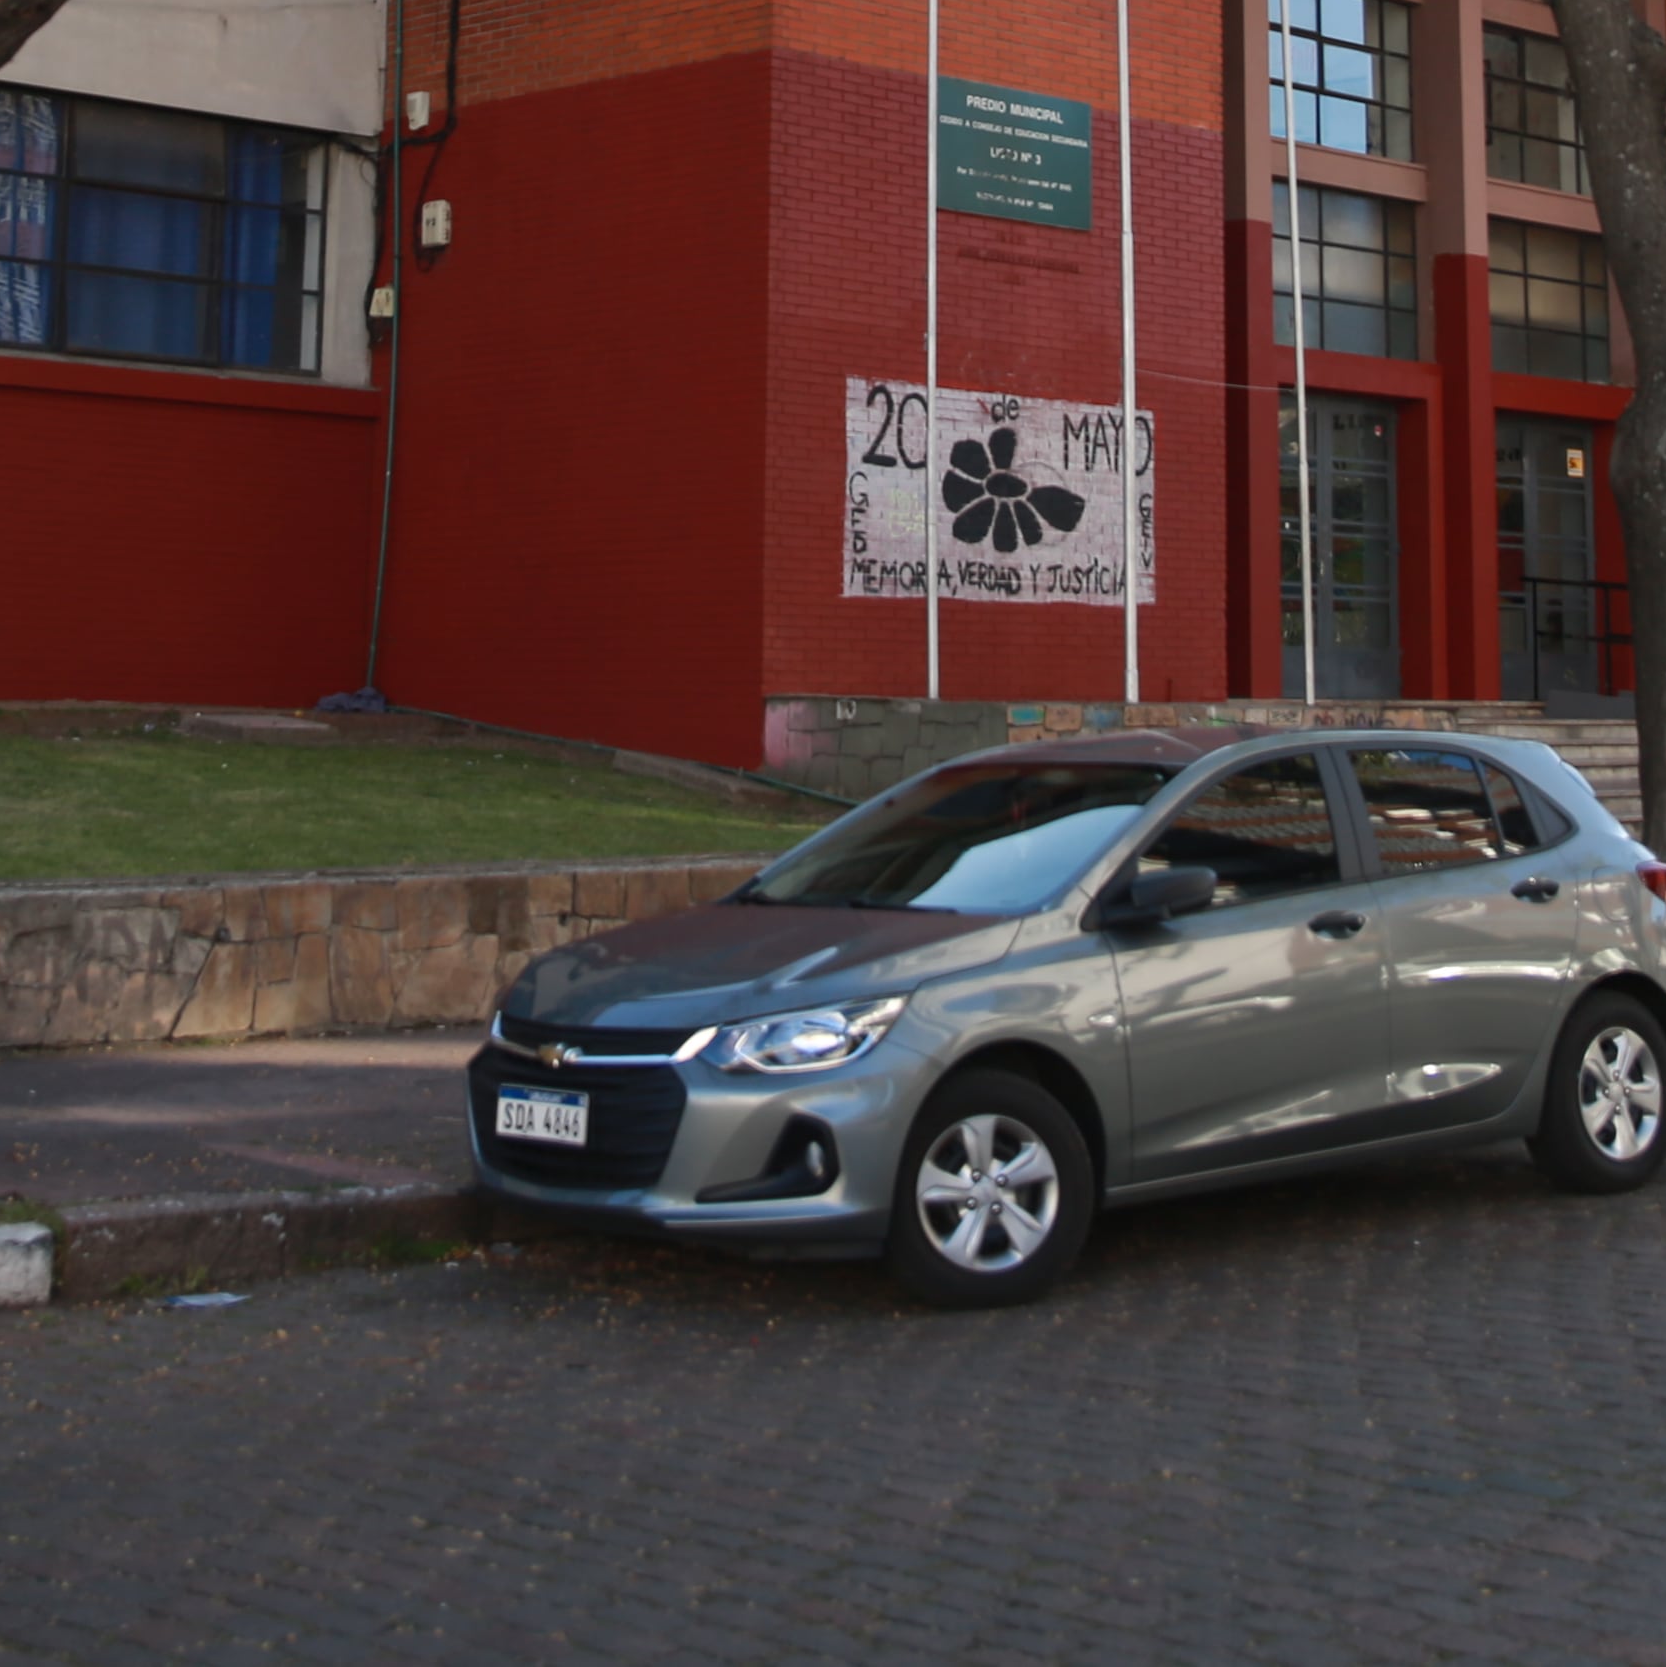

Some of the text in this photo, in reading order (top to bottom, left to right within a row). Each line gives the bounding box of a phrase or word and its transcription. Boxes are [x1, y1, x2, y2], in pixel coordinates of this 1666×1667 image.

[966, 95, 1064, 124] PREDIO MUNICIPAL
[1004, 126, 1013, 135] DE
[1034, 154, 1041, 165] 3
[862, 385, 1152, 477] 20 de MAYO
[850, 558, 957, 596] MEMORA,
[958, 560, 1021, 595] VERDAD
[1029, 563, 1041, 595] Y
[503, 1102, 580, 1138] SDA 4846
